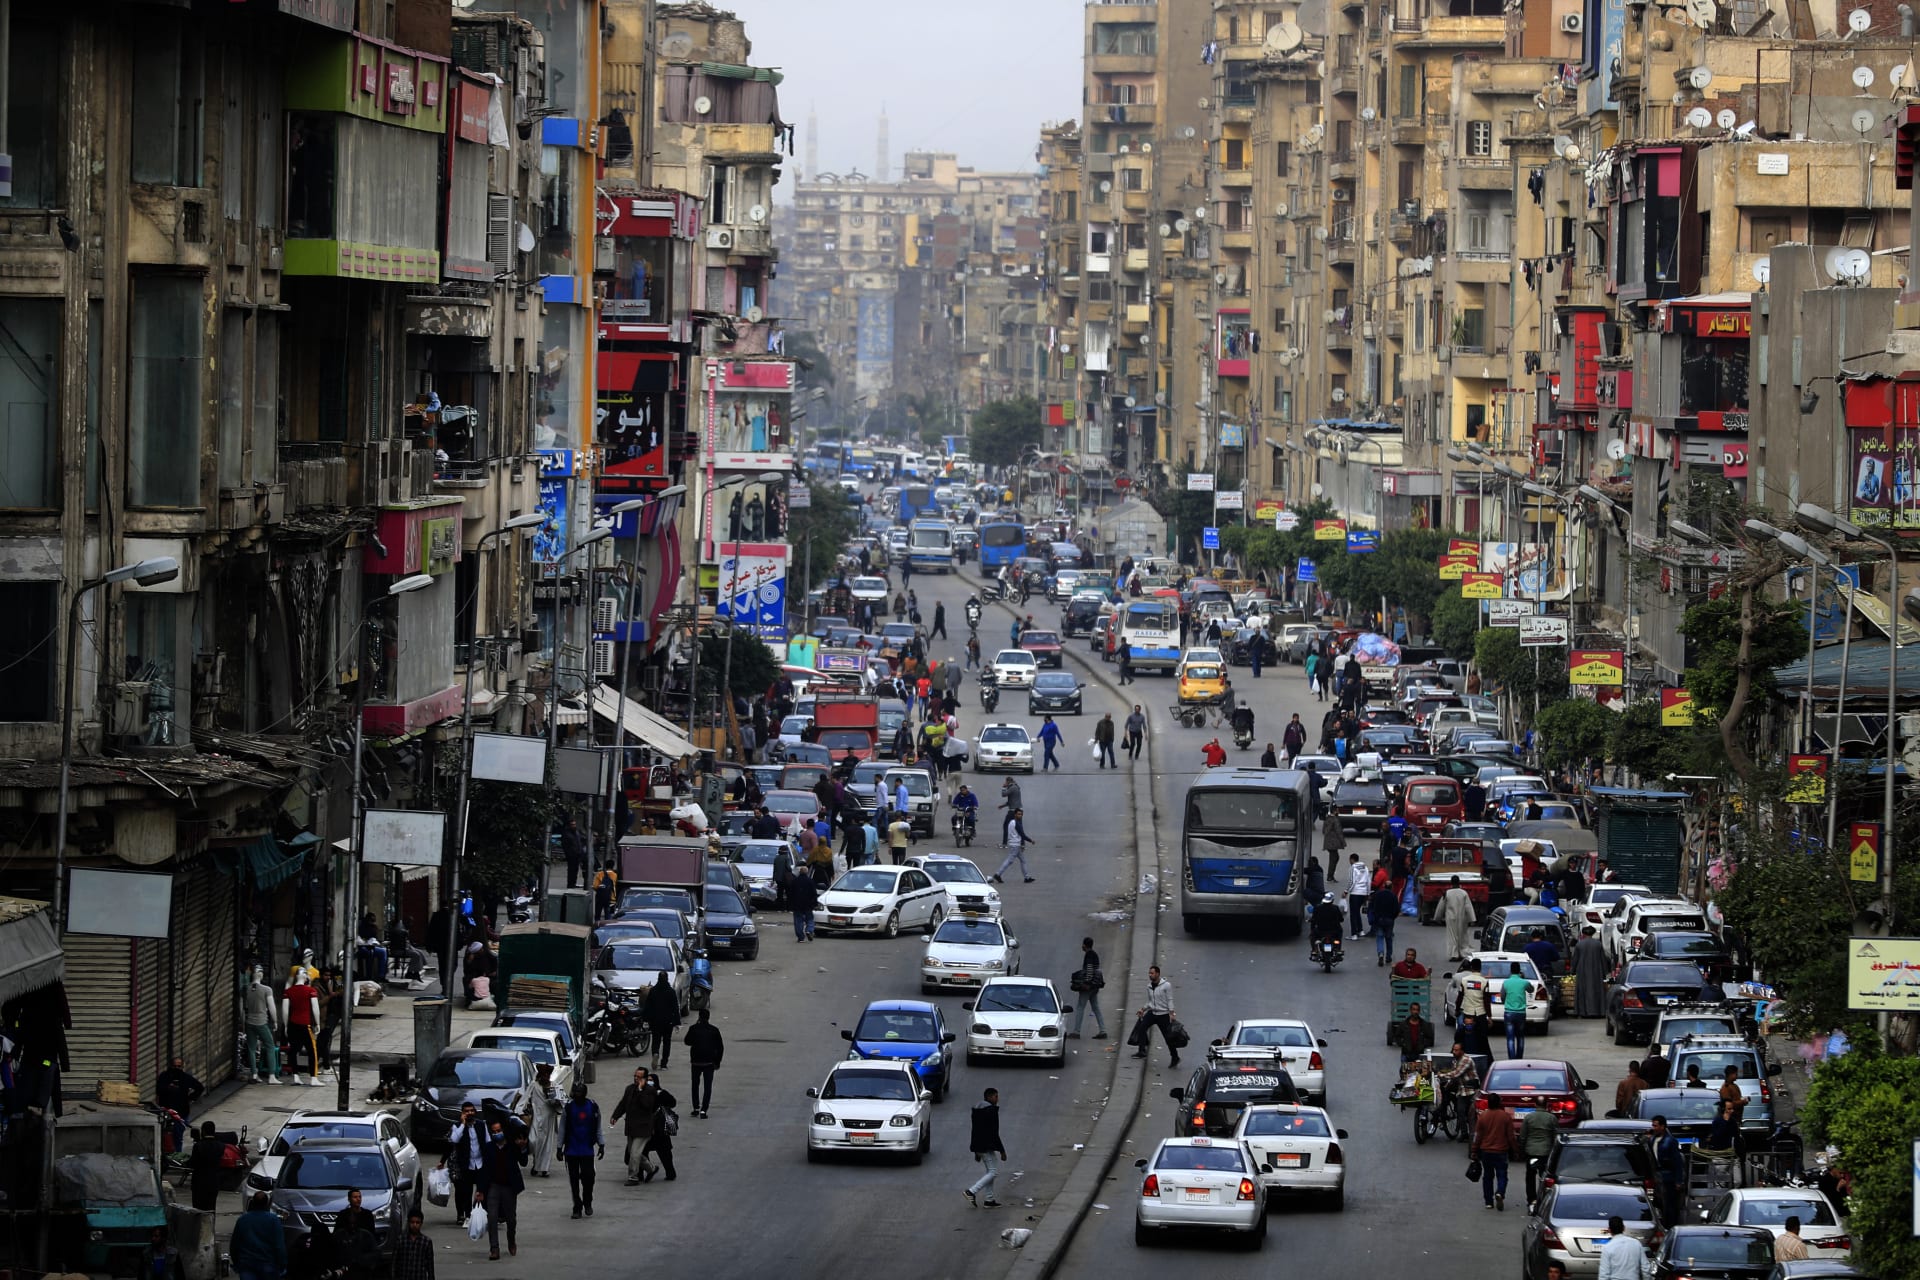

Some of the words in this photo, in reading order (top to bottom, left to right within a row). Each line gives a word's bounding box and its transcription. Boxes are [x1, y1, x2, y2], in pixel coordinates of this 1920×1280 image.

[1708, 312, 1739, 335] الشام
[614, 396, 651, 437] أبو
[1870, 961, 1903, 971] الشروق
